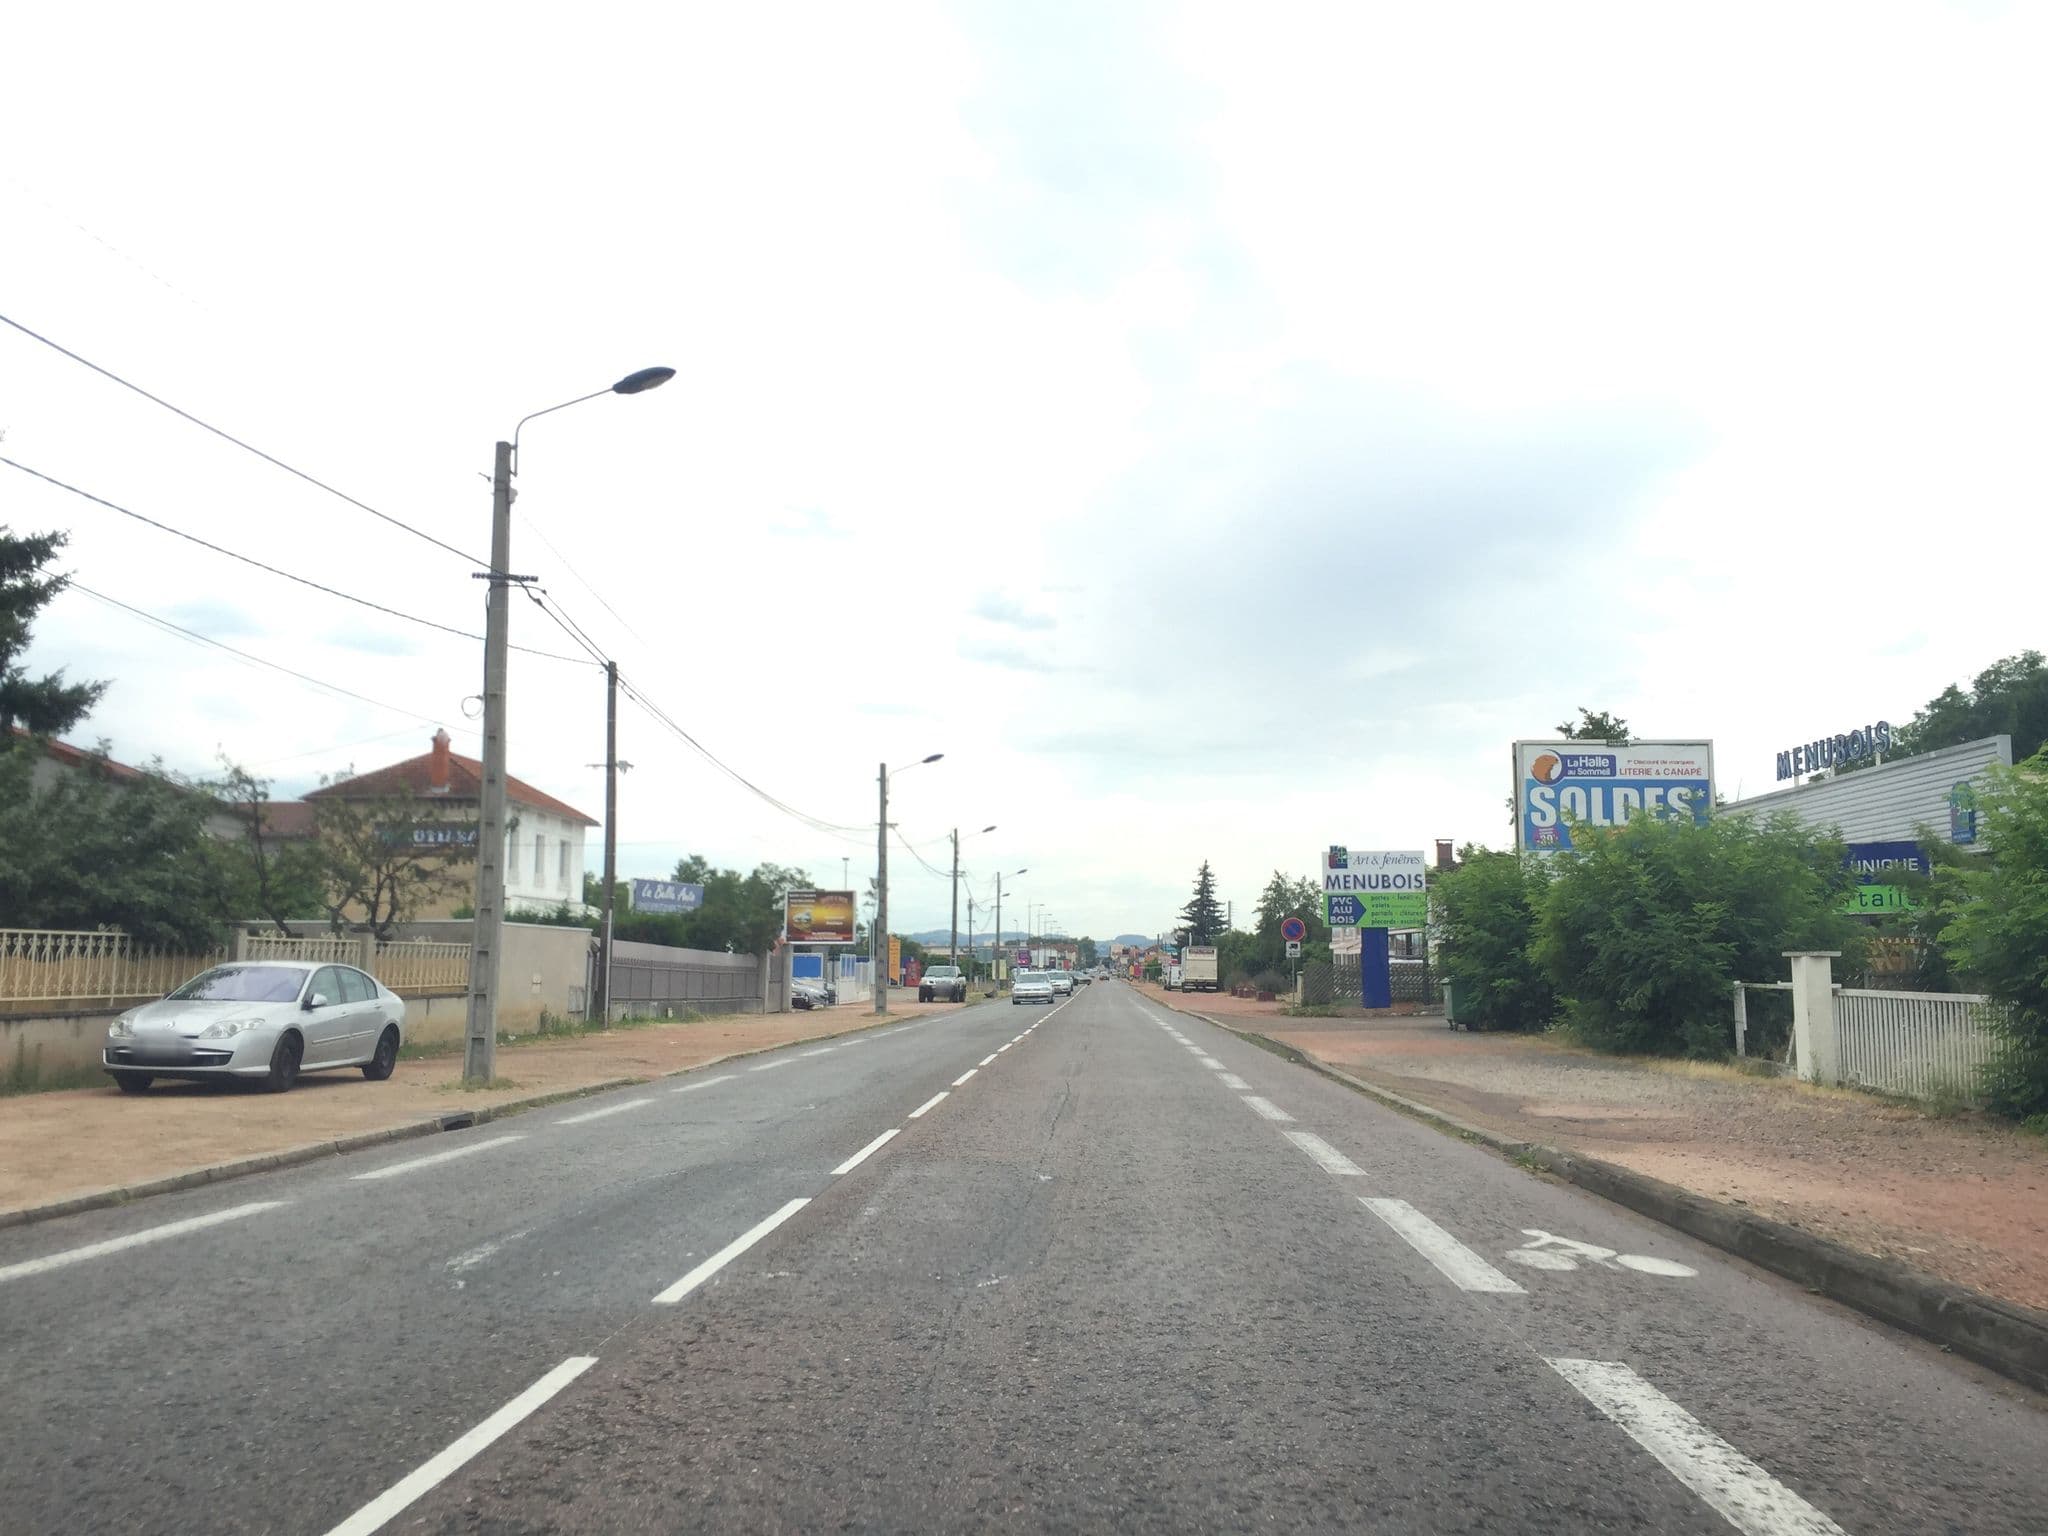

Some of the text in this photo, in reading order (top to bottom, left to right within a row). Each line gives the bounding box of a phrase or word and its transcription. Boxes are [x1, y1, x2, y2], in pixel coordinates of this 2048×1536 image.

[1776, 720, 1891, 781] MENUBOIS
[1567, 756, 1610, 767] La Halle
[1577, 767, 1611, 776] Sommeil
[1619, 767, 1652, 776] LITERIE
[1353, 852, 1421, 870] Art & fenêtres
[1325, 874, 1423, 890] MENUBOIS
[1332, 896, 1353, 905] PVC
[1332, 906, 1353, 914] ALU
[1330, 915, 1355, 924] BOIS
